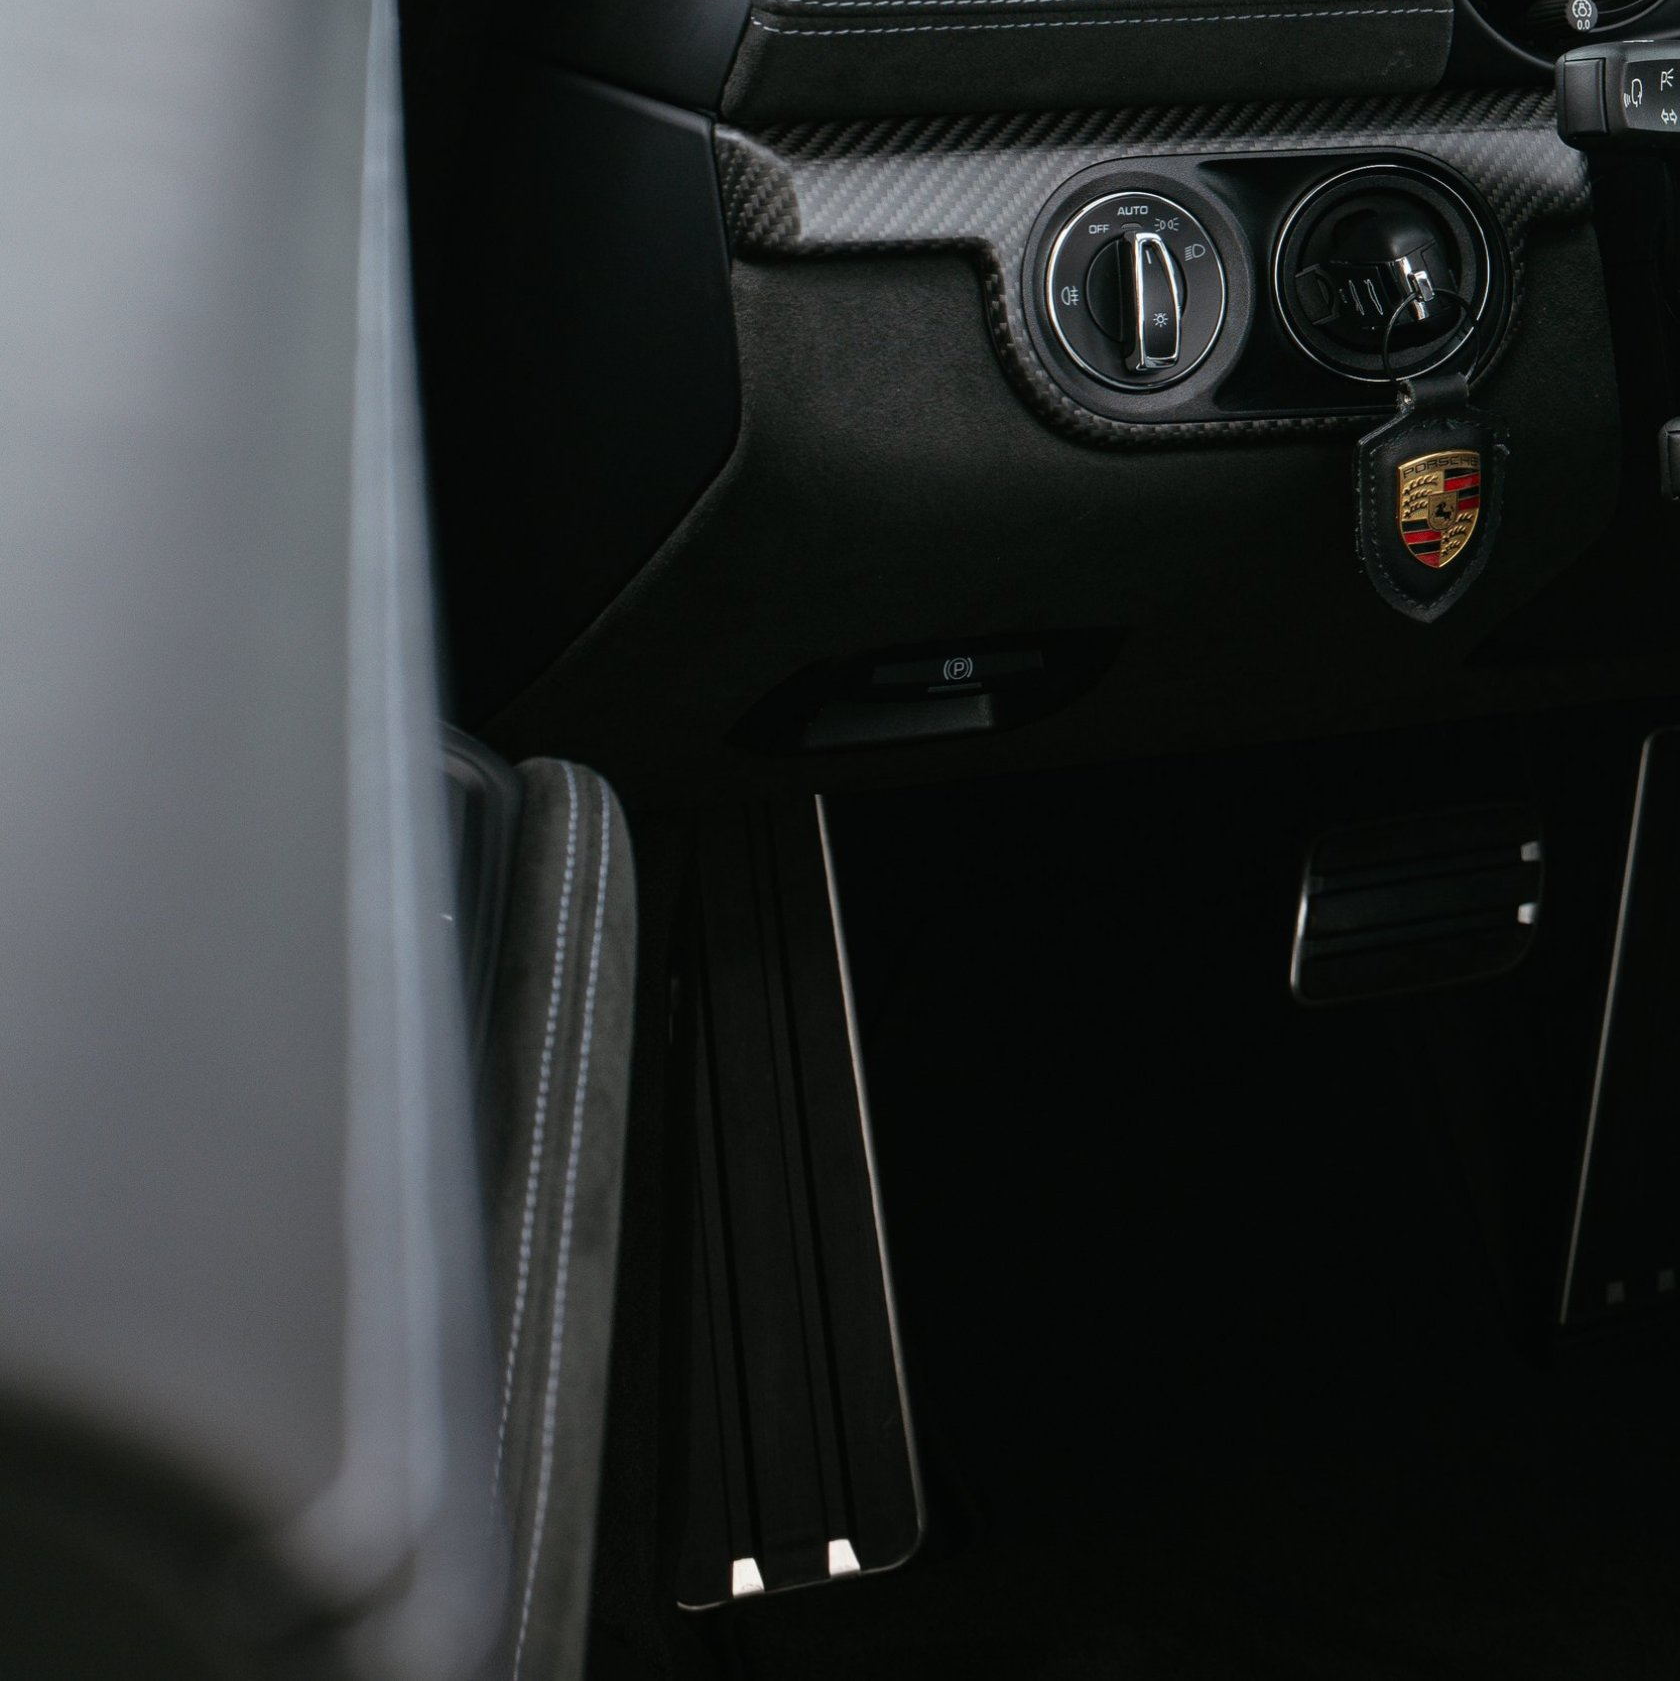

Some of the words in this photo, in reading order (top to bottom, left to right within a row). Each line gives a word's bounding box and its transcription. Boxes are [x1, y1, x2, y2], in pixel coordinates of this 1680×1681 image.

[1576, 19, 1591, 31] 0.0
[1116, 205, 1149, 216] AUTO
[1088, 224, 1110, 235] OFF
[1402, 455, 1478, 479] PORSCHE
